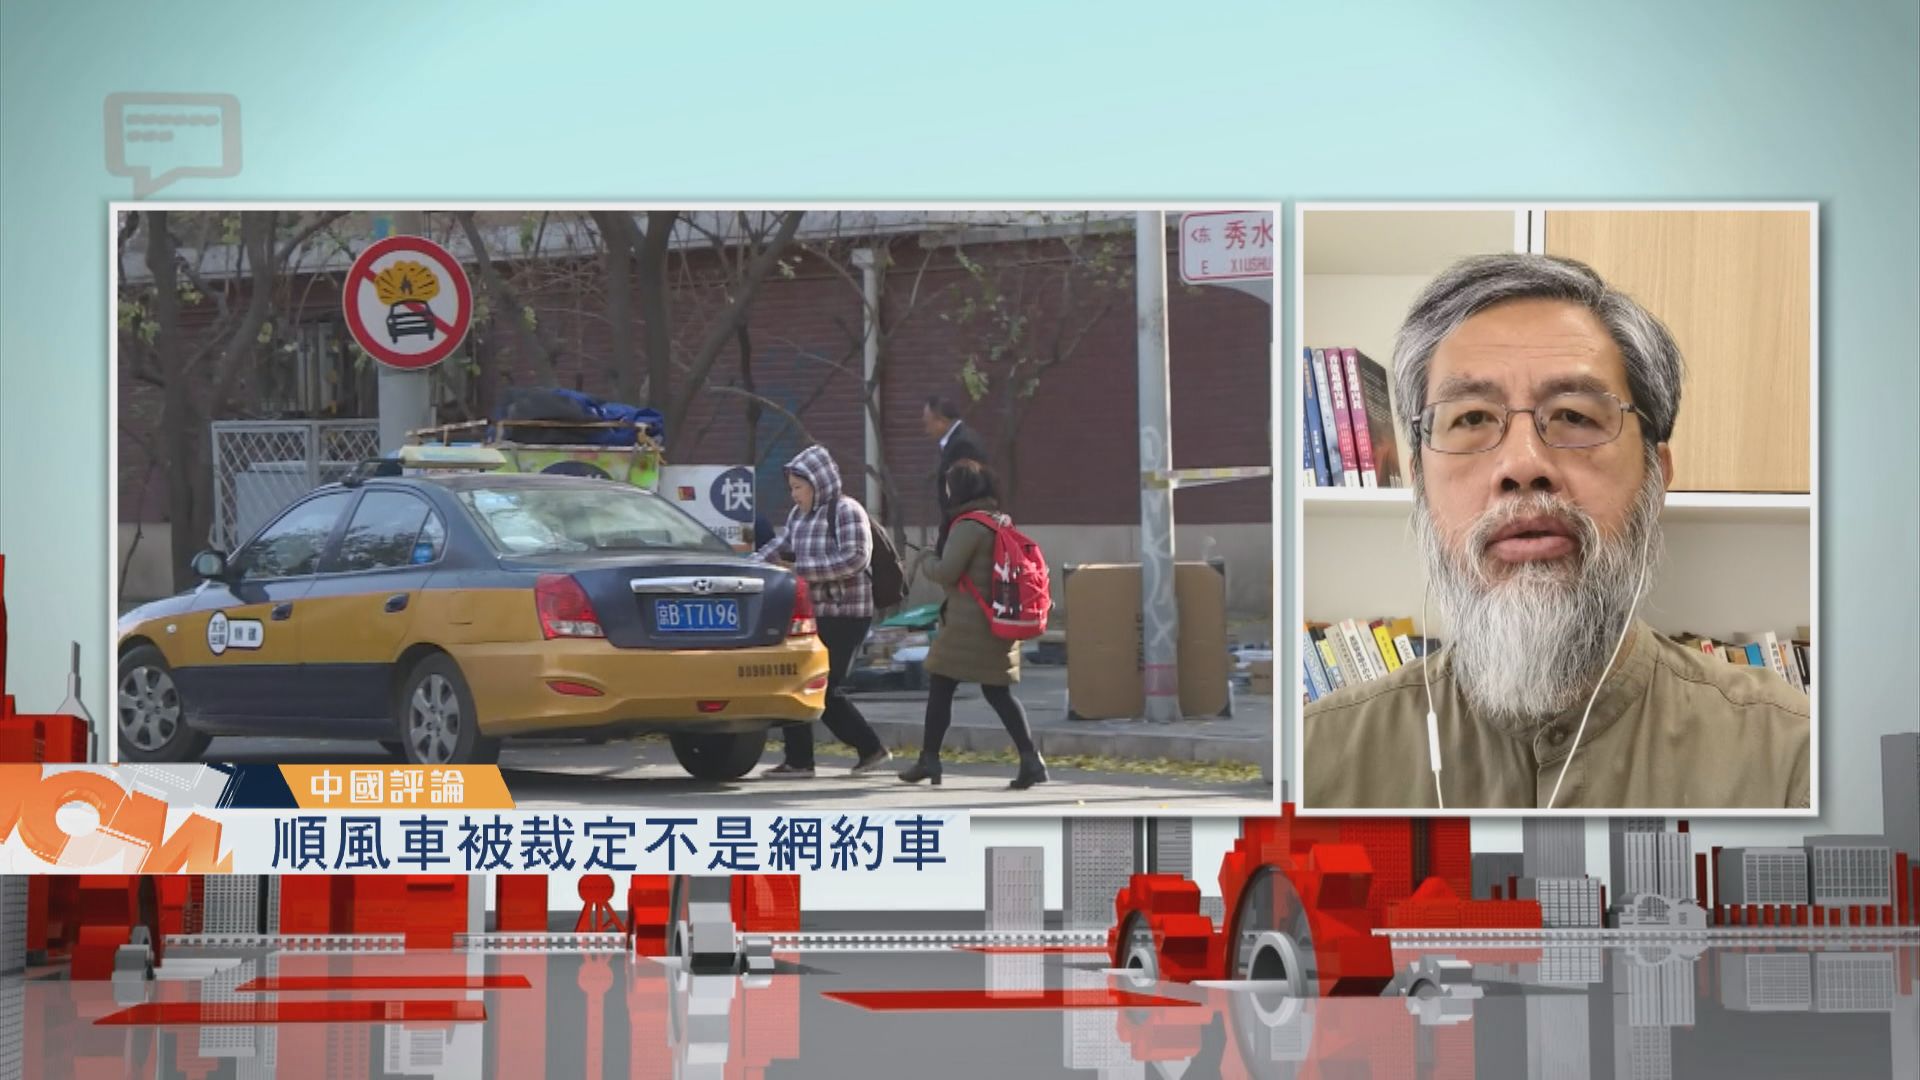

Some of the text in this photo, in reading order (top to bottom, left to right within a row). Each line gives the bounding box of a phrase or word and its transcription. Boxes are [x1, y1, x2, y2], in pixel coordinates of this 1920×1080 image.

[1224, 218, 1272, 250] 秀水
[1201, 260, 1209, 275] E
[721, 478, 752, 511] 快
